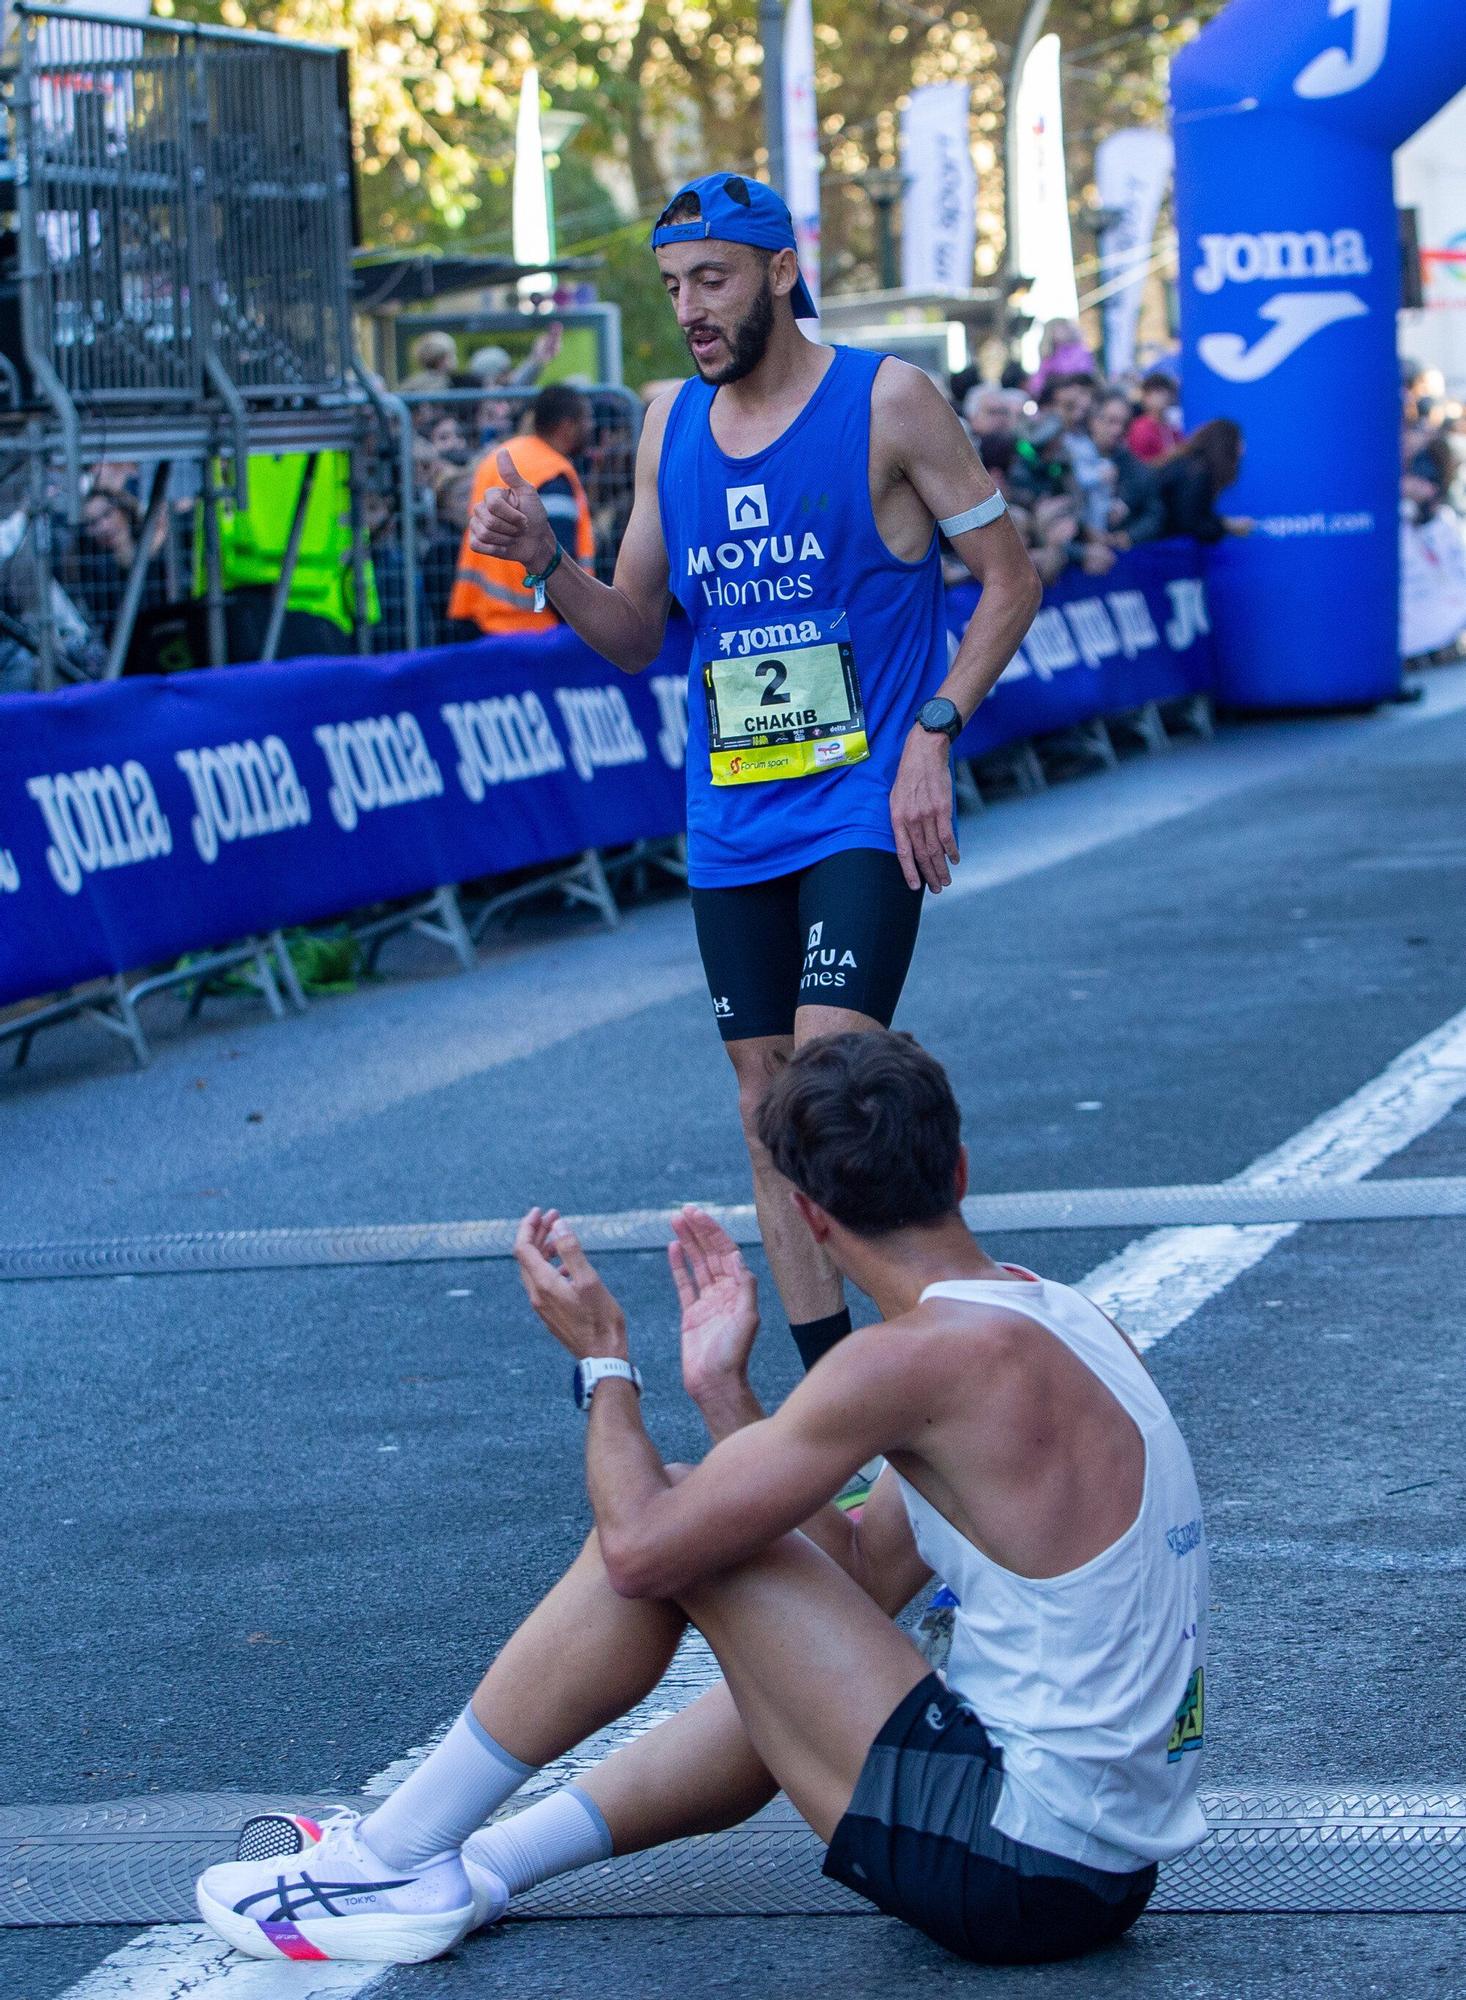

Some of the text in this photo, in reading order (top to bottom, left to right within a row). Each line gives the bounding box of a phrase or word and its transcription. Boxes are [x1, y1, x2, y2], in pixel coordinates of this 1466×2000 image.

[687, 532, 825, 576] MOYUA
[701, 574, 814, 606] Homes
[755, 659, 791, 707] 2
[744, 709, 818, 732] CHAKIB
[768, 758, 789, 768] sport
[345, 1895, 377, 1906] TOKYO
